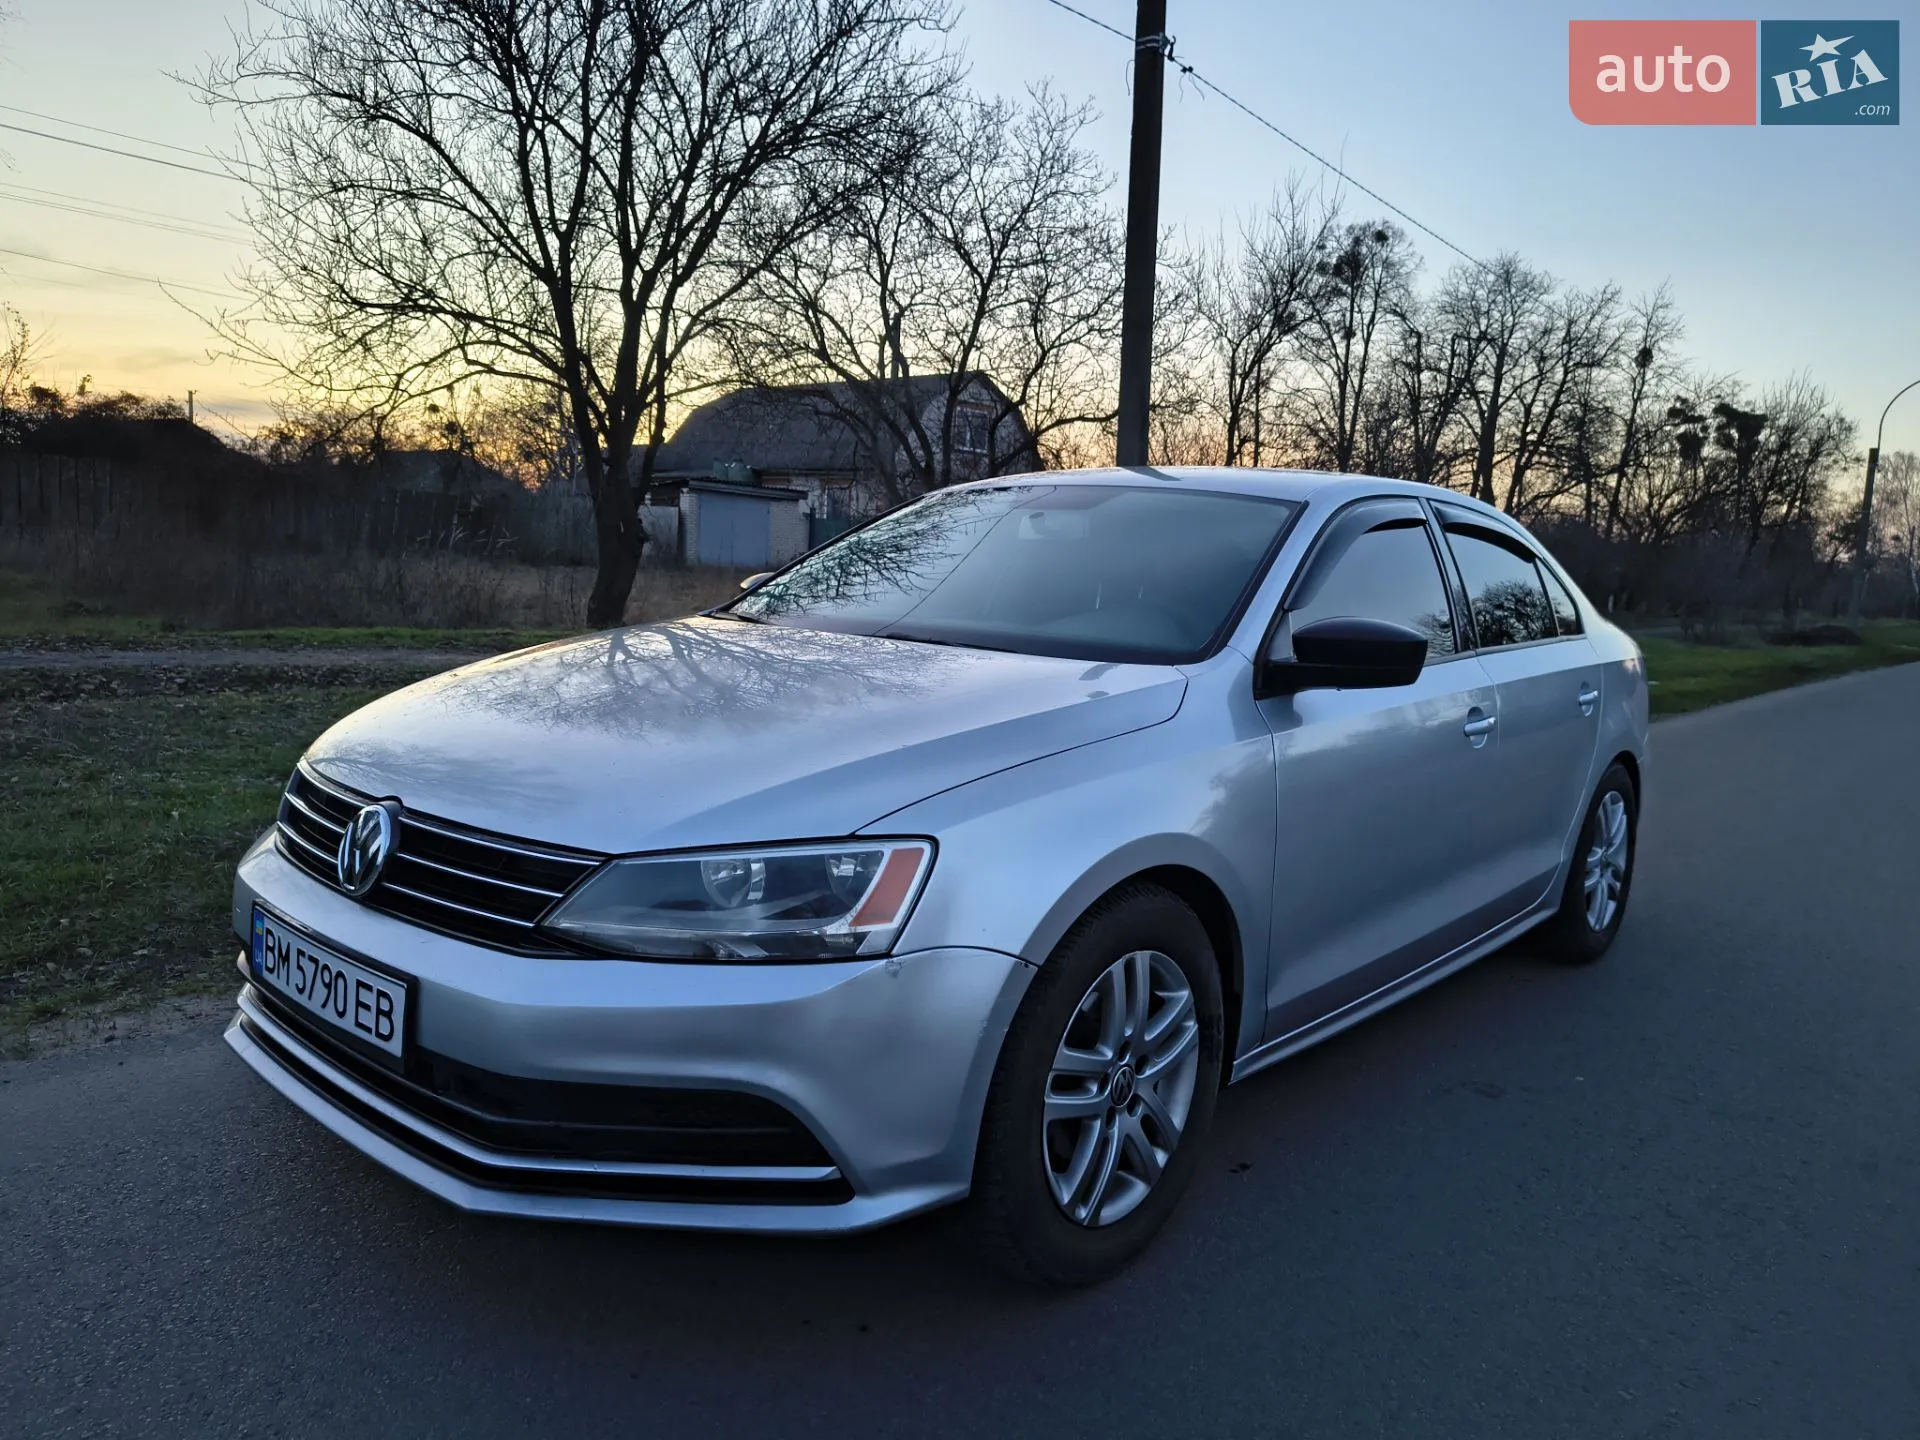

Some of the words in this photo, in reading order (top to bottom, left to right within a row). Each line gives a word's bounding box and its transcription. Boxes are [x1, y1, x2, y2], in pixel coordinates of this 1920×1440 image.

[264, 926, 291, 989] BM
[295, 947, 348, 1020] 5790
[354, 977, 395, 1043] EB
